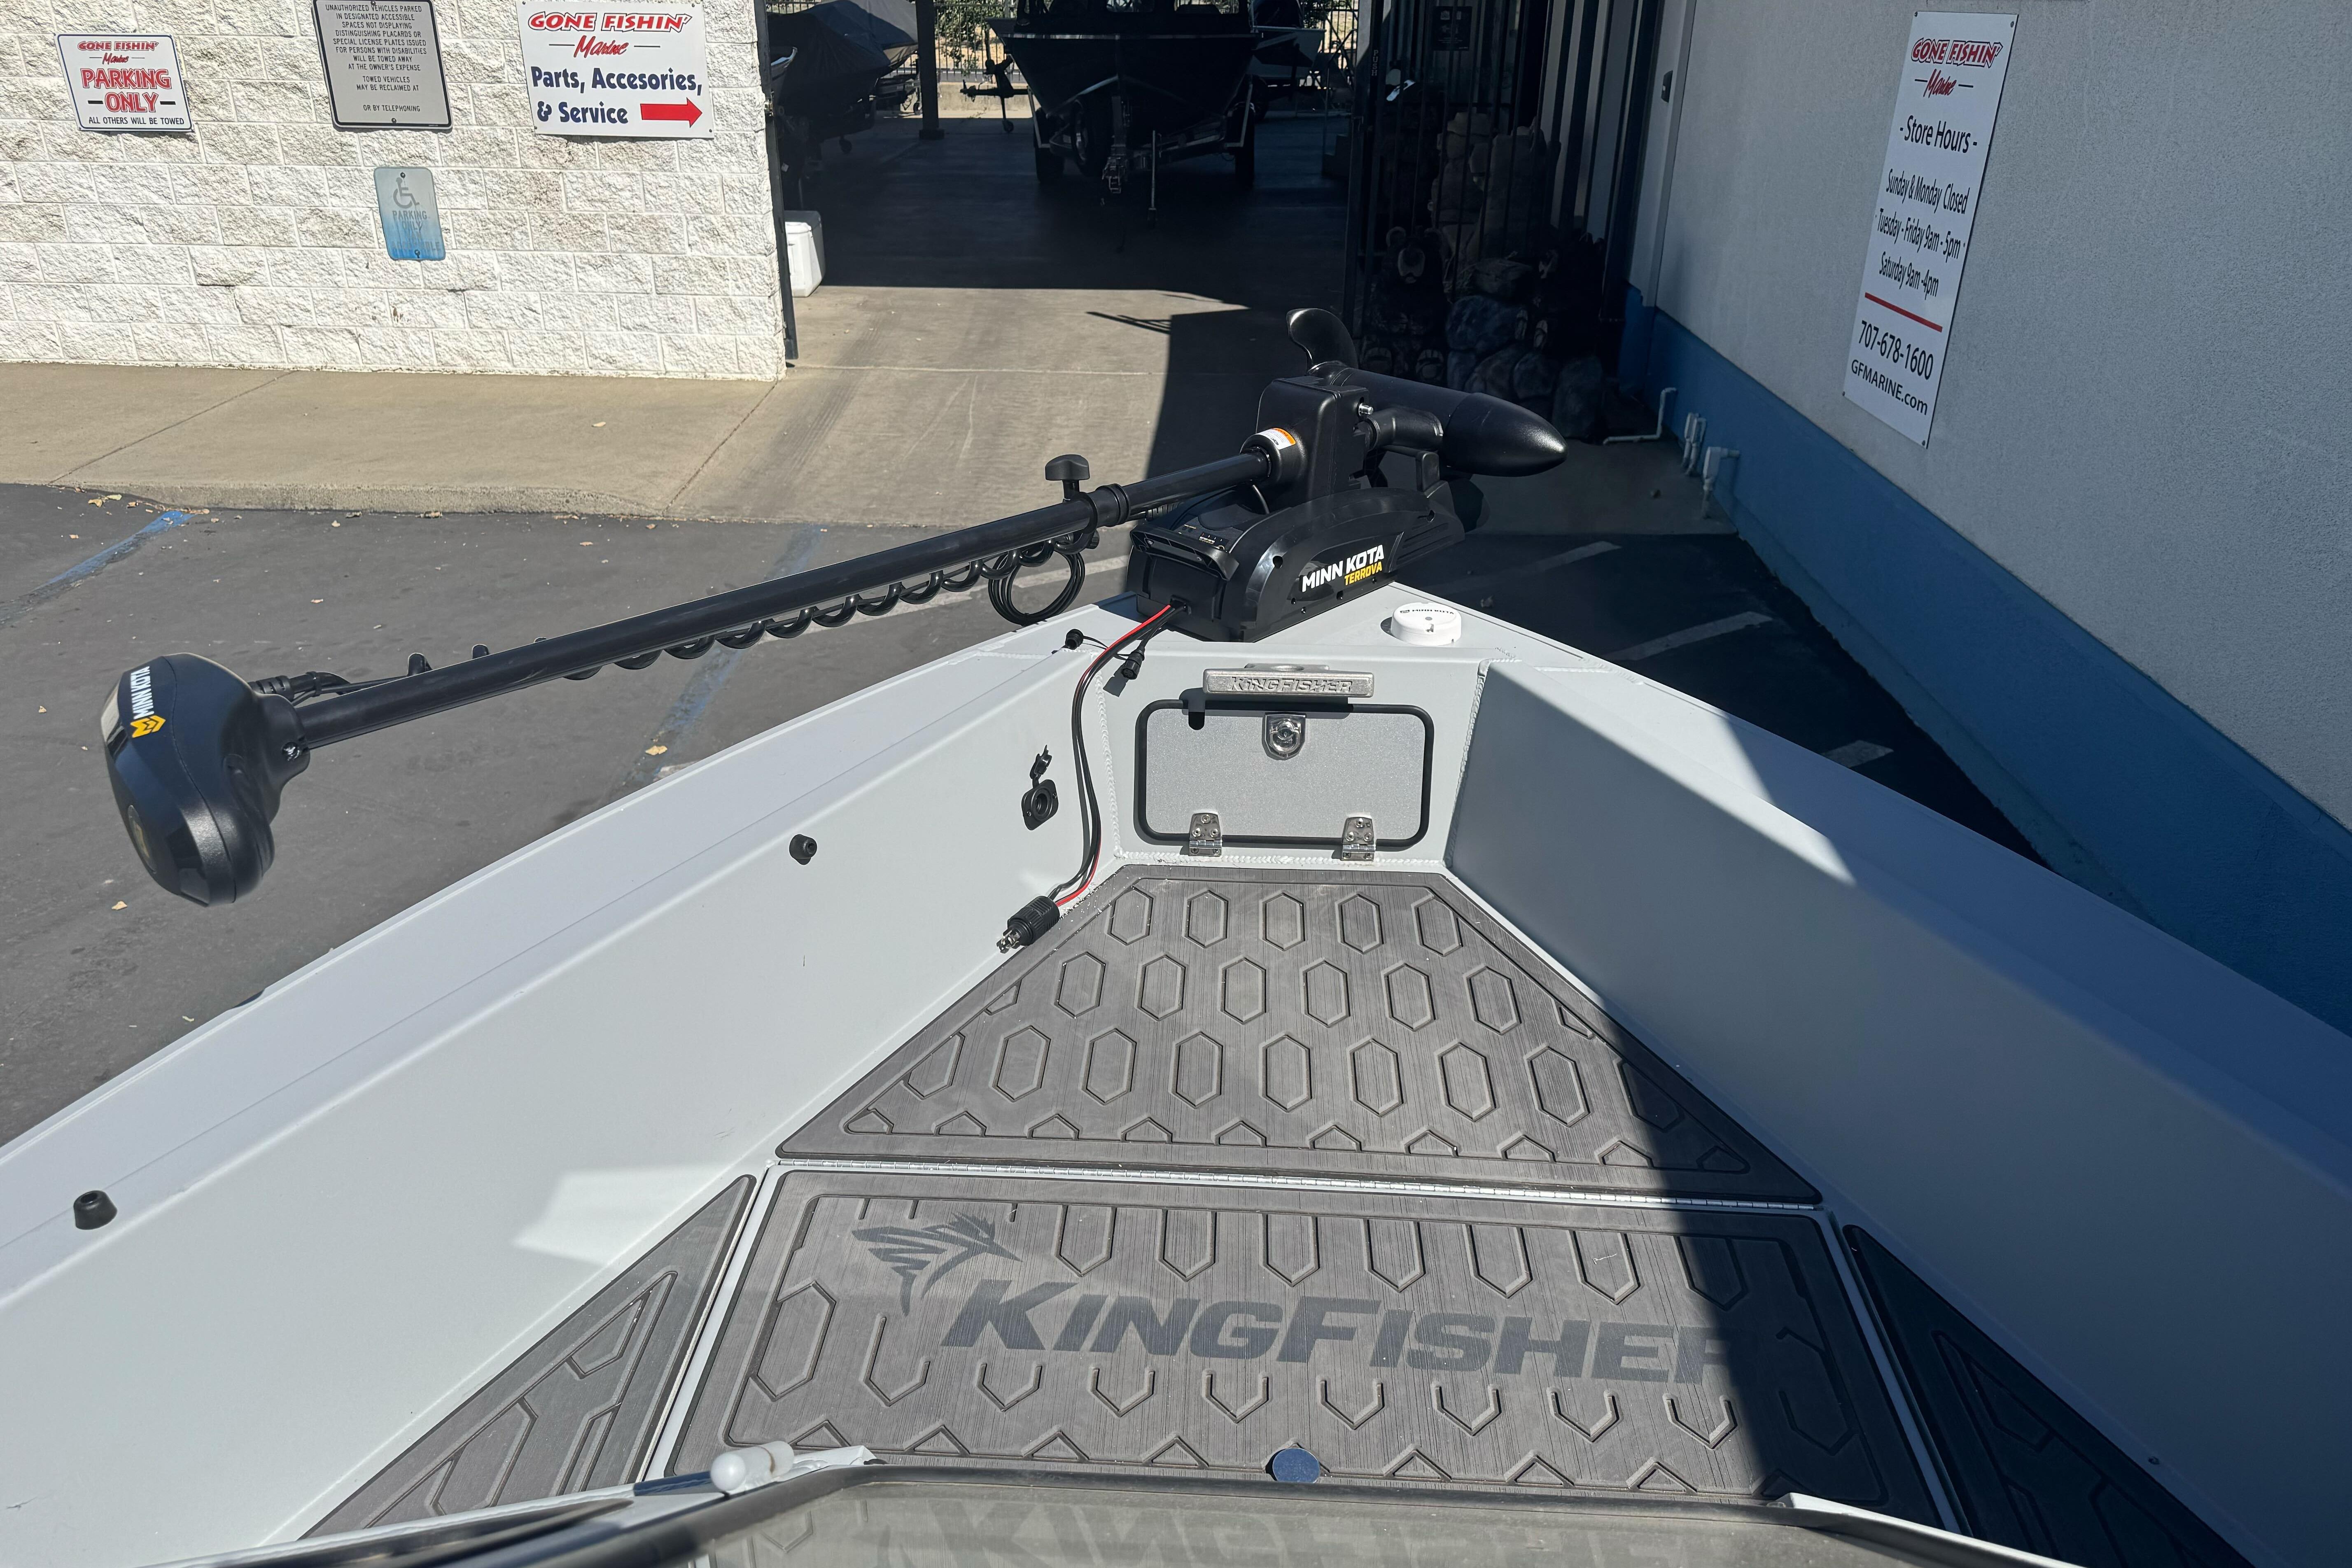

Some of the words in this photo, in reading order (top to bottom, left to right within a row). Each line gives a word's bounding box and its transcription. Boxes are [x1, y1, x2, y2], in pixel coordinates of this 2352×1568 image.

[528, 12, 597, 31] GONE
[601, 13, 693, 33] FISHIN'
[78, 41, 111, 51] GONE
[114, 41, 159, 51] FISHIN'
[573, 35, 629, 58] Marine
[1911, 37, 1950, 64] GONE
[1946, 40, 2003, 68] FISHIN'
[80, 68, 172, 89] PARKING
[530, 66, 584, 93] Parts,
[592, 67, 702, 96] Accesories,
[105, 92, 158, 112] ONLY
[537, 101, 552, 122] &
[558, 101, 628, 124] Service
[1904, 115, 1933, 145] Store
[1934, 120, 1971, 153] Hours
[1886, 168, 1910, 203] Sunday
[1909, 175, 1915, 199] &
[1914, 176, 1942, 213] Monday
[1944, 183, 1970, 214] Closed
[392, 210, 427, 219] PARKING
[1877, 208, 1902, 244] Tuesday
[1904, 217, 1925, 253] Friday
[1924, 224, 1939, 252] 9am
[1943, 231, 1960, 263] 5pm
[1879, 251, 1906, 289] Saturday
[1906, 262, 1920, 289] 9am
[1859, 320, 1933, 380] 707-678-1600
[1851, 359, 1927, 415] GFMARINE.com
[1302, 560, 1343, 593] MINN
[1346, 544, 1384, 574] KOTA
[1344, 561, 1382, 586] TERROVA
[131, 666, 151, 692] KOTA
[1231, 677, 1352, 693] KINGFISHER
[131, 688, 154, 719] MINN
